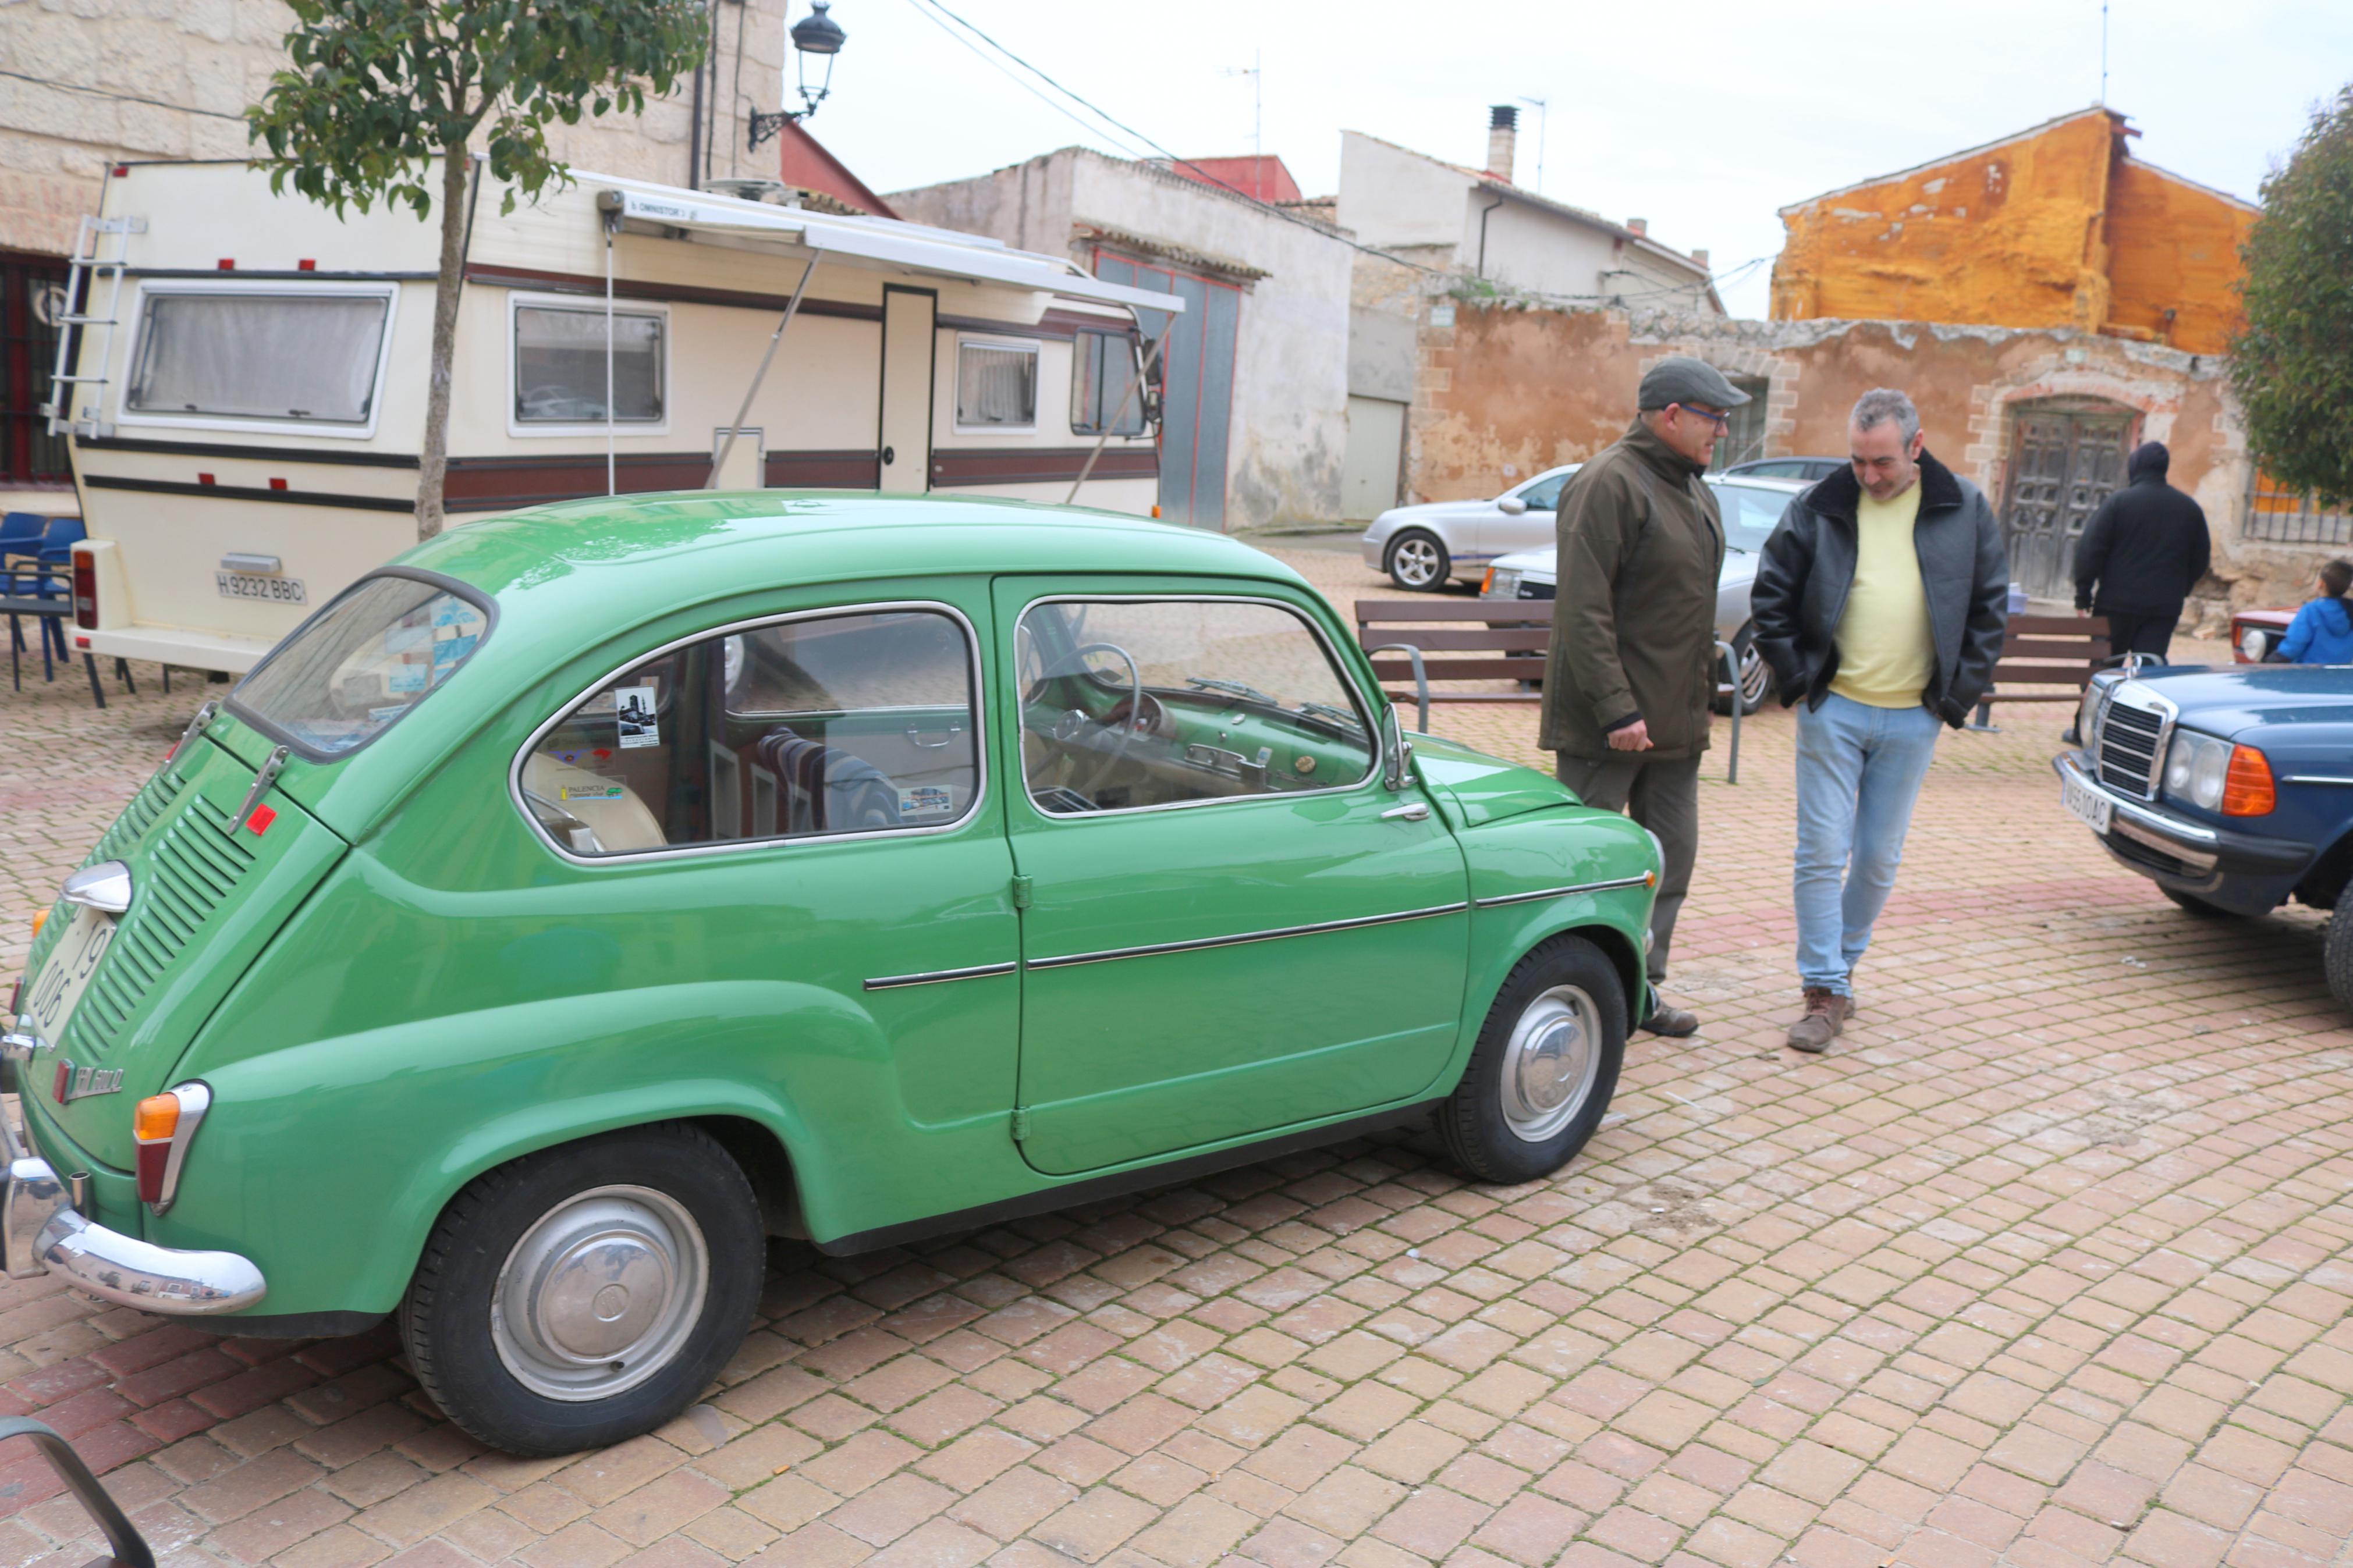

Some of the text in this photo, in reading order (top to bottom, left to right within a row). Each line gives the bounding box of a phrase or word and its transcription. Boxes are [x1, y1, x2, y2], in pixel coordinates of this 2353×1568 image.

[217, 575, 301, 600] H 9232 BBC
[33, 961, 70, 1028] 006
